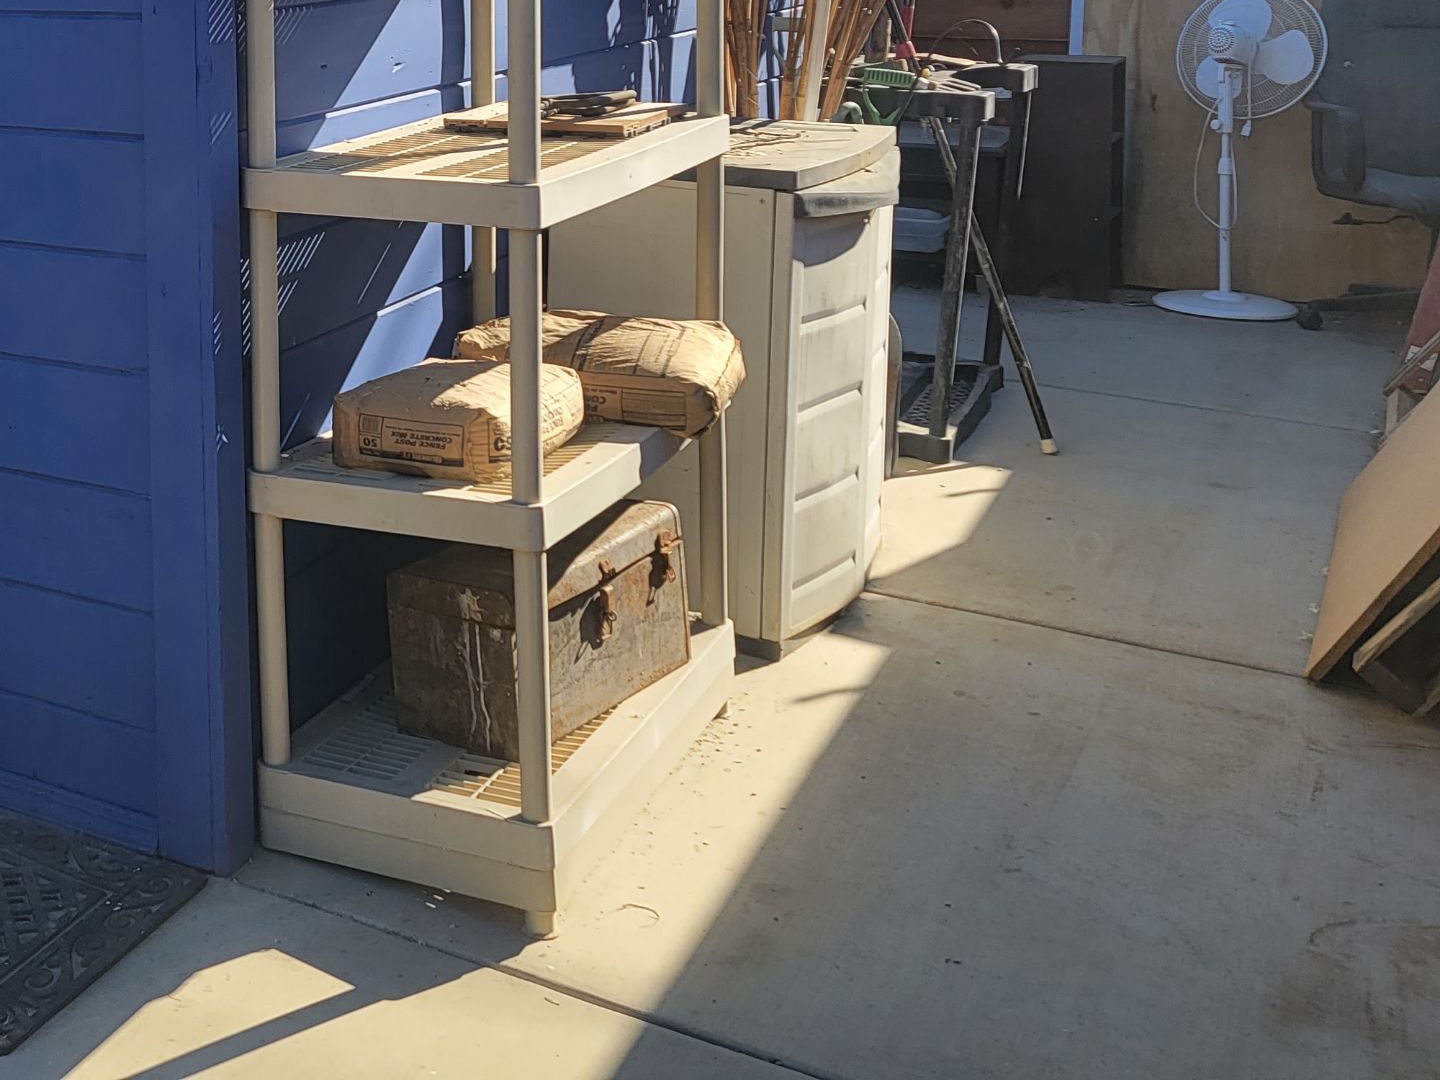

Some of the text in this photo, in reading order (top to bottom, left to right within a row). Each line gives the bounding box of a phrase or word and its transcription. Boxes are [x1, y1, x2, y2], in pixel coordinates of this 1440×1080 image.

[391, 430, 408, 439] MIX
[409, 432, 453, 443] CONCRETE
[363, 437, 378, 448] 50
[394, 438, 447, 450] FENCE POST
